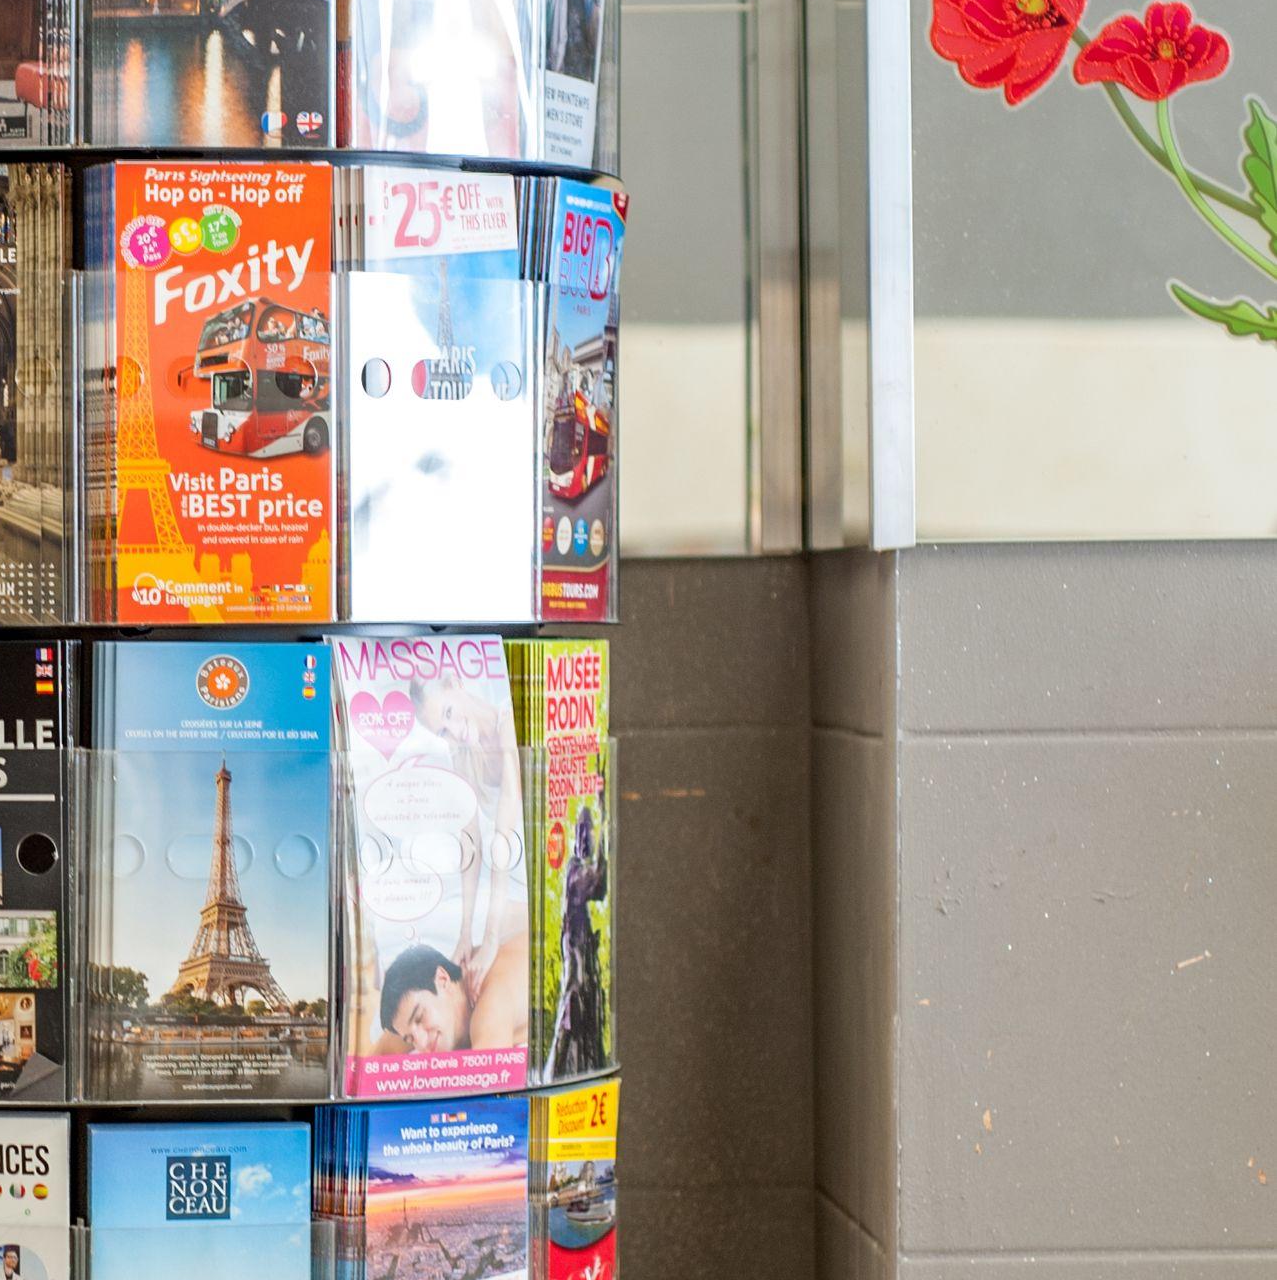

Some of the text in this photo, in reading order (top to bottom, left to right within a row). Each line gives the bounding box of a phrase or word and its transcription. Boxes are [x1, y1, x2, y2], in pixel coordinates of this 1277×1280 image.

[145, 167, 306, 186] Paris Sightseeing Tour
[145, 184, 184, 207] Hop
[189, 189, 213, 203] on
[231, 184, 271, 207] Hop
[275, 184, 304, 203] off
[458, 183, 481, 210] OFF
[391, 181, 455, 248] 25€
[562, 211, 592, 256] BIG
[154, 238, 315, 326] Foxity
[170, 467, 283, 491] Visit Paris
[189, 493, 323, 524] BEST price
[165, 594, 224, 609] languages
[338, 640, 505, 681] MASSAGE
[547, 651, 600, 692] MUSÉE
[547, 695, 596, 732] RODIN
[549, 756, 587, 775] AUGUSTE
[549, 799, 568, 819] 2017
[376, 1069, 511, 1092] www.lovemassage.fr
[401, 1122, 498, 1140] Want to experience
[383, 1134, 515, 1157] the whole beauty of Paris?
[169, 1162, 228, 1181] CHE
[170, 1179, 227, 1198] NON
[169, 1196, 227, 1216] CEAU
